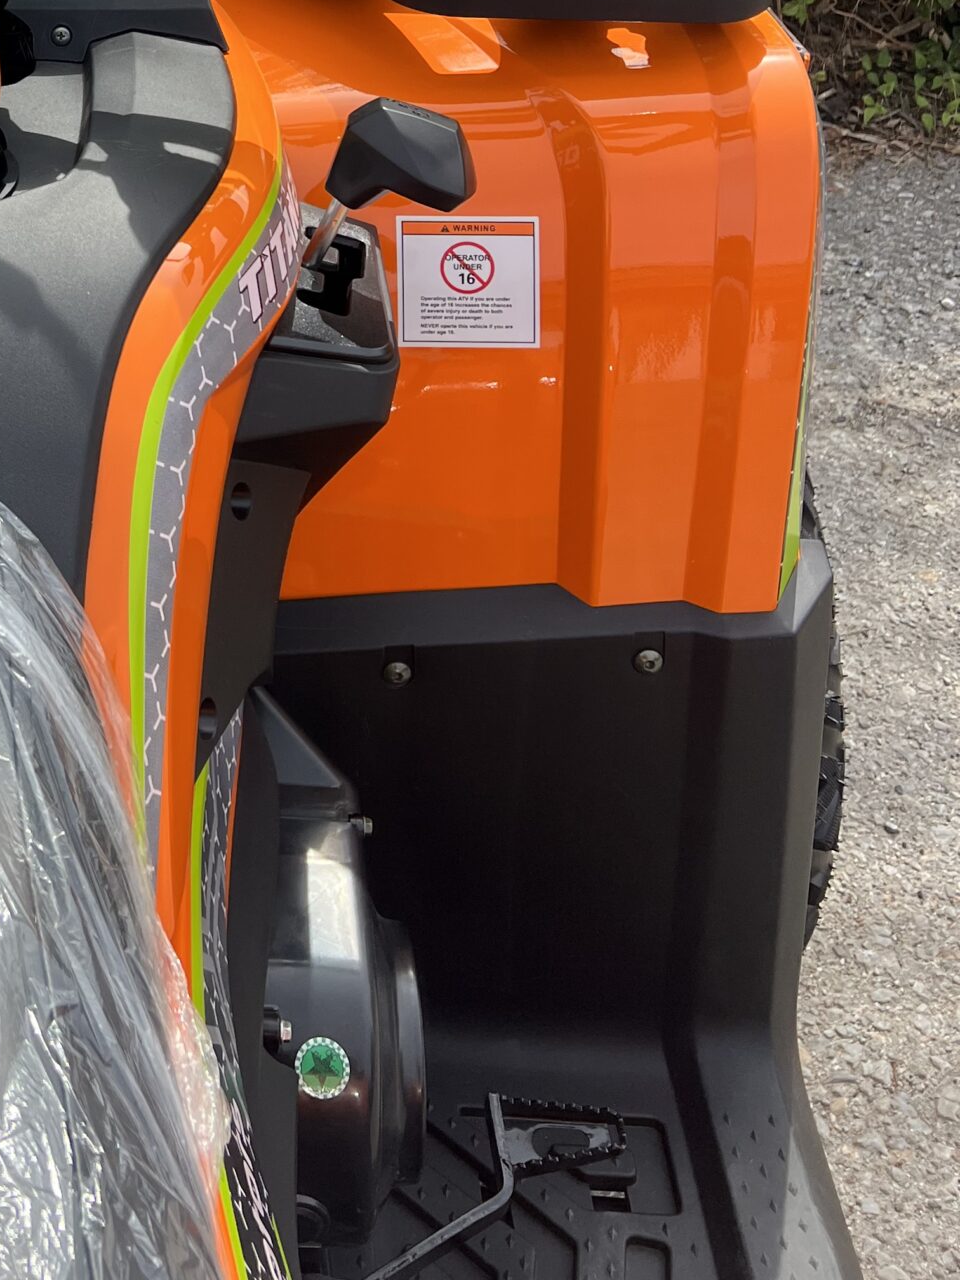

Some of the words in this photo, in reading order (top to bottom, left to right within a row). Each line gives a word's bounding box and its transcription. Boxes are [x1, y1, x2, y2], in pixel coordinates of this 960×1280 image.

[452, 224, 496, 232] WARNING
[239, 183, 300, 323] TITAN
[453, 263, 482, 271] UNDER
[458, 273, 475, 285] 16
